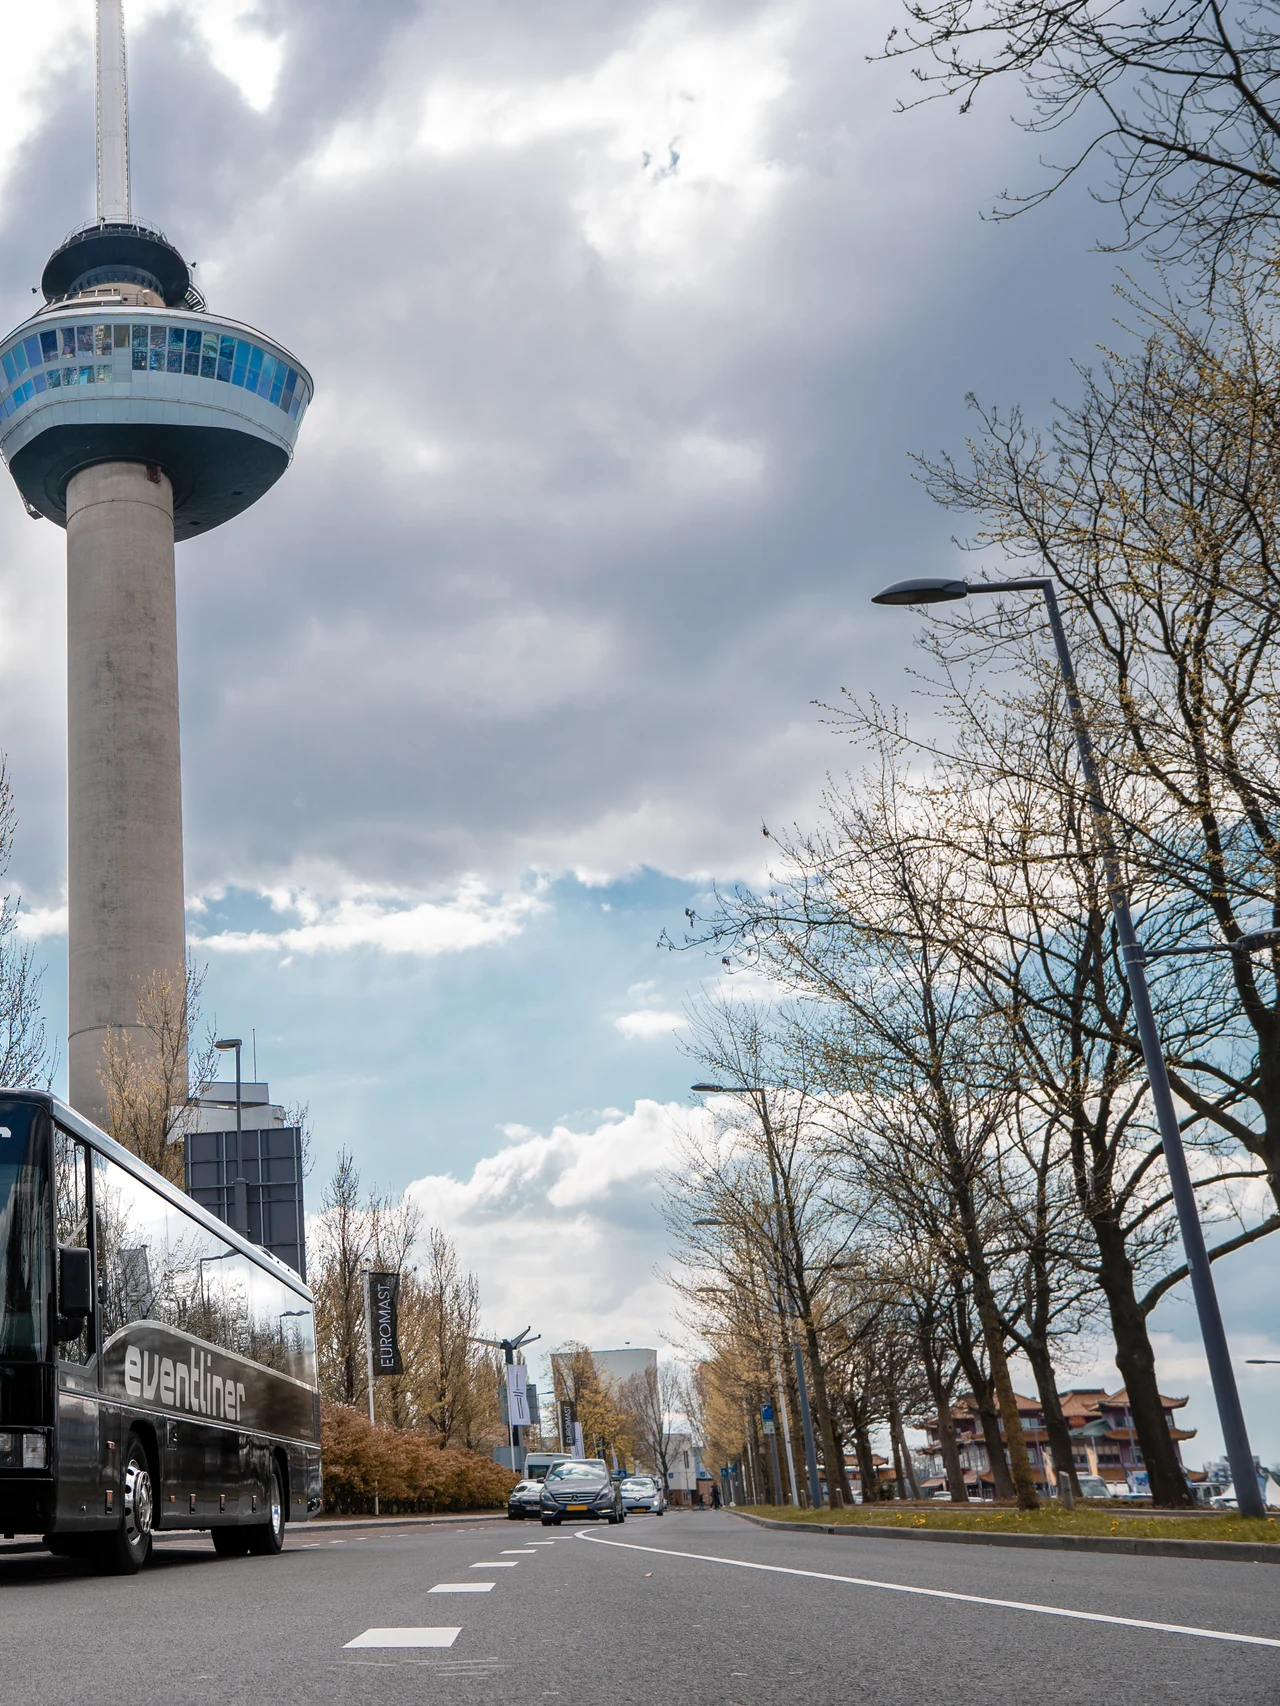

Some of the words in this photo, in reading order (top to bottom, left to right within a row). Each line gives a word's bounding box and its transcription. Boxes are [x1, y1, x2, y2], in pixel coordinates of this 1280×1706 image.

[377, 1283, 395, 1367] EUROMAST
[124, 1344, 246, 1422] eventliner
[564, 1405, 573, 1444] EUROMAST
